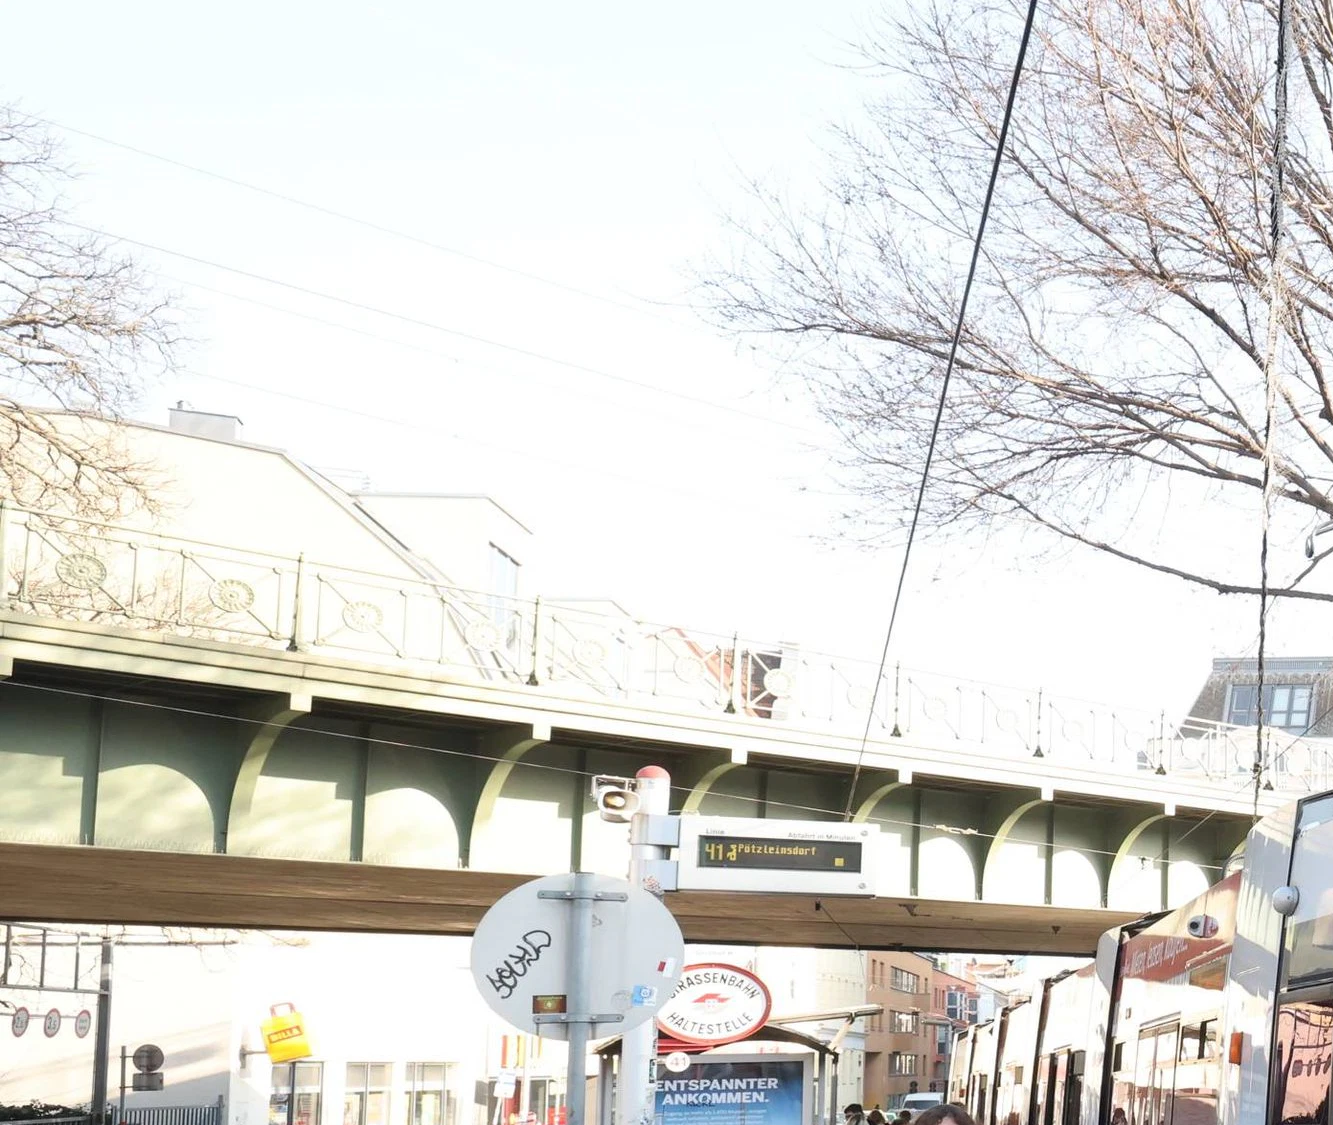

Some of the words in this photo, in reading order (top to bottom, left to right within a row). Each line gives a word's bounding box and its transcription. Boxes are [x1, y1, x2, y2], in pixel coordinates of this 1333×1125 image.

[705, 843, 723, 861] 41
[738, 843, 816, 856] Pötzleinsdorf
[667, 1012, 753, 1035] HALTESTELLE
[670, 1057, 687, 1067] 41
[655, 1078, 778, 1092] ENTSPANNTER
[662, 1092, 770, 1106] ANKOMMEN.
